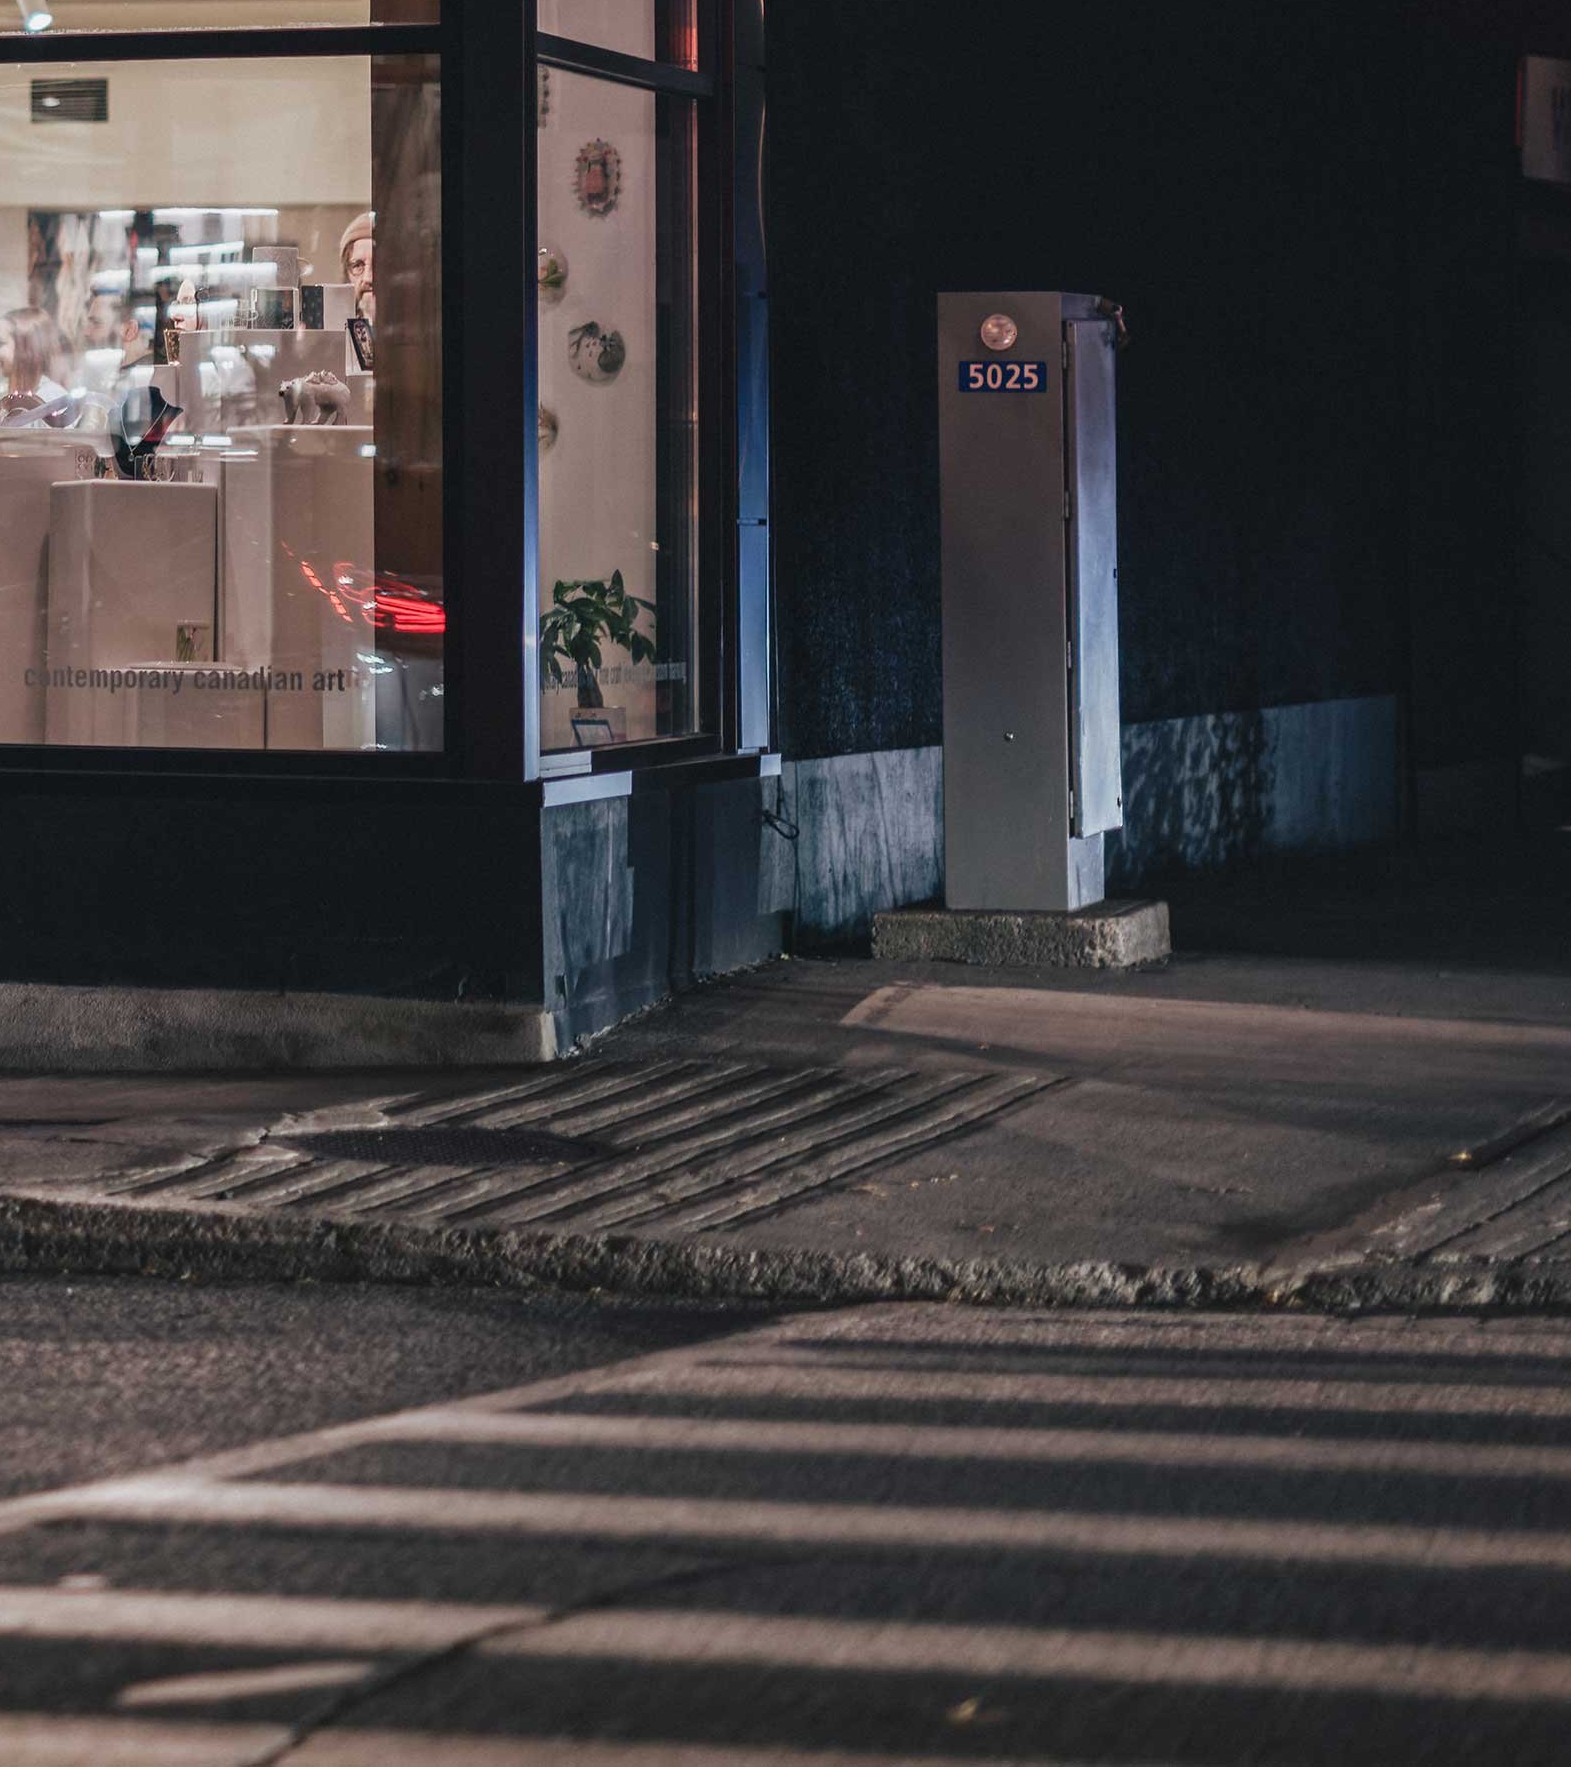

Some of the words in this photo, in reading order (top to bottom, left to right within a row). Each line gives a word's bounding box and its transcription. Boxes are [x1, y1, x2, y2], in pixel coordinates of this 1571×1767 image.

[969, 364, 1039, 389] 5025
[24, 666, 185, 694] contemporary
[193, 667, 303, 692] canadian
[312, 670, 345, 692] art
